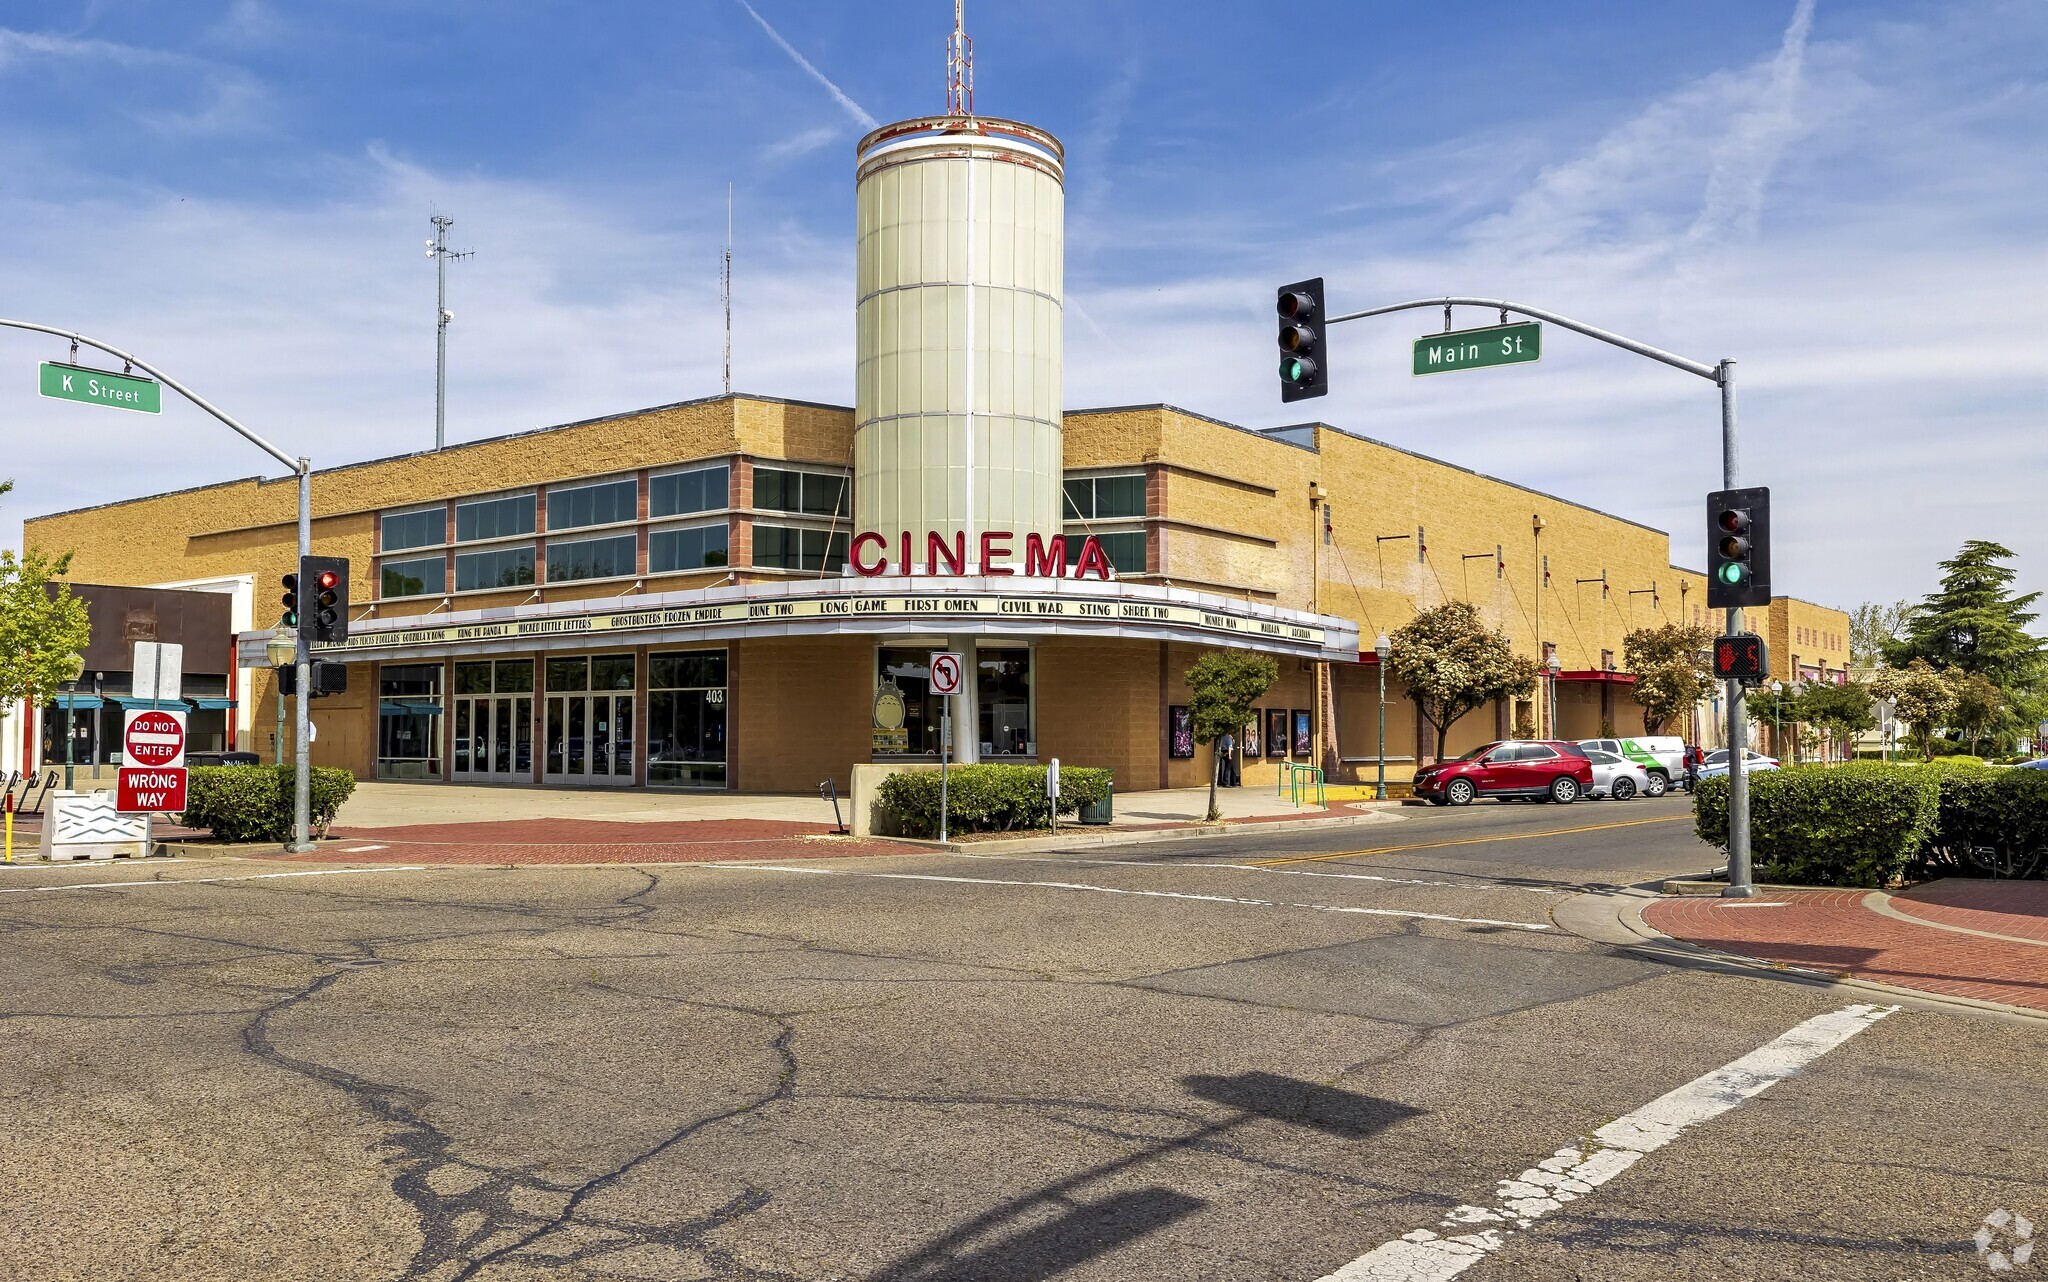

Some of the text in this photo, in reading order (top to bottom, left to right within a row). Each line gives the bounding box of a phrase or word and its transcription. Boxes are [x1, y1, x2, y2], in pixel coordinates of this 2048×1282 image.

[1429, 335, 1522, 365] Main St
[62, 375, 139, 402] K Street
[850, 530, 1110, 581] CINEMA
[750, 604, 793, 617] DUNE TWO
[820, 600, 887, 613] LONG GAME
[904, 600, 978, 611] FIRST OMEN
[1001, 601, 1063, 614] CIVIL WAR
[1079, 603, 1110, 616] STING
[1123, 605, 1169, 618] SHREK TWO
[611, 608, 722, 627] GHOSTBUSTERS FROZEN EMPIRE
[1204, 615, 1237, 629] MONKEY MAN
[458, 629, 471, 638] KUNG
[474, 628, 480, 637] FU
[483, 626, 501, 636] PANDA
[518, 619, 591, 633] WICKED LITTLE LETTERS
[402, 630, 445, 642] GODZILLA X KONG
[1748, 645, 1758, 671] 5
[706, 689, 723, 703] 403
[135, 721, 176, 732] DO NOT
[135, 746, 173, 756] ENTER
[128, 774, 177, 789] WRONG
[137, 792, 167, 807] WAY
